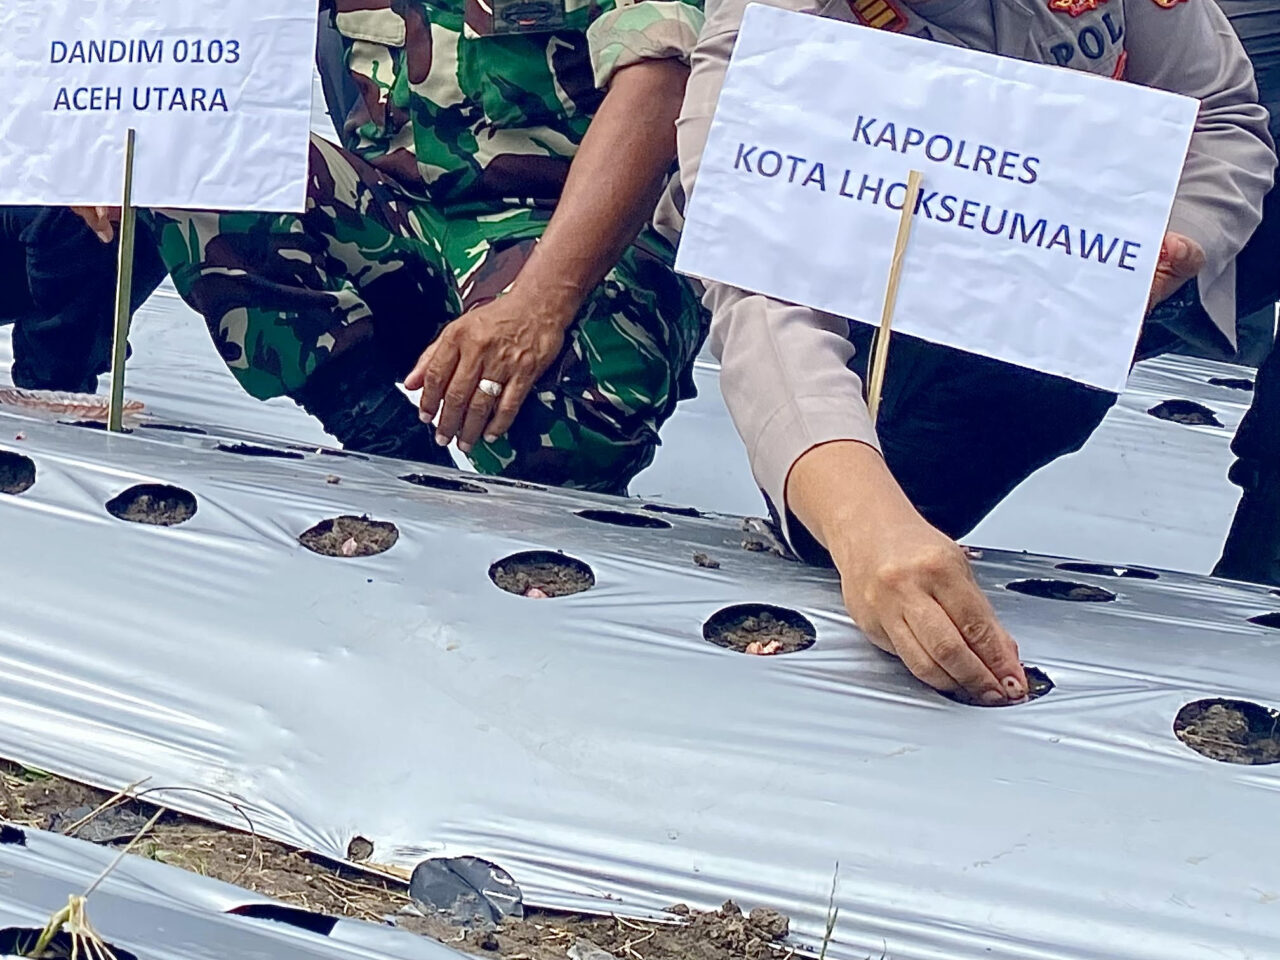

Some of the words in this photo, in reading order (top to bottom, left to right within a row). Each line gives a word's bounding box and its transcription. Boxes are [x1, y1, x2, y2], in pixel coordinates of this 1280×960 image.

[49, 39, 164, 64] DANDIM
[172, 39, 241, 64] 0103
[53, 86, 122, 111] ACEH
[131, 86, 229, 112] UTARA
[851, 114, 1041, 185] KAPOLRES
[733, 142, 827, 192] KOTA
[838, 168, 1142, 272] LHOKSEUMAWE
